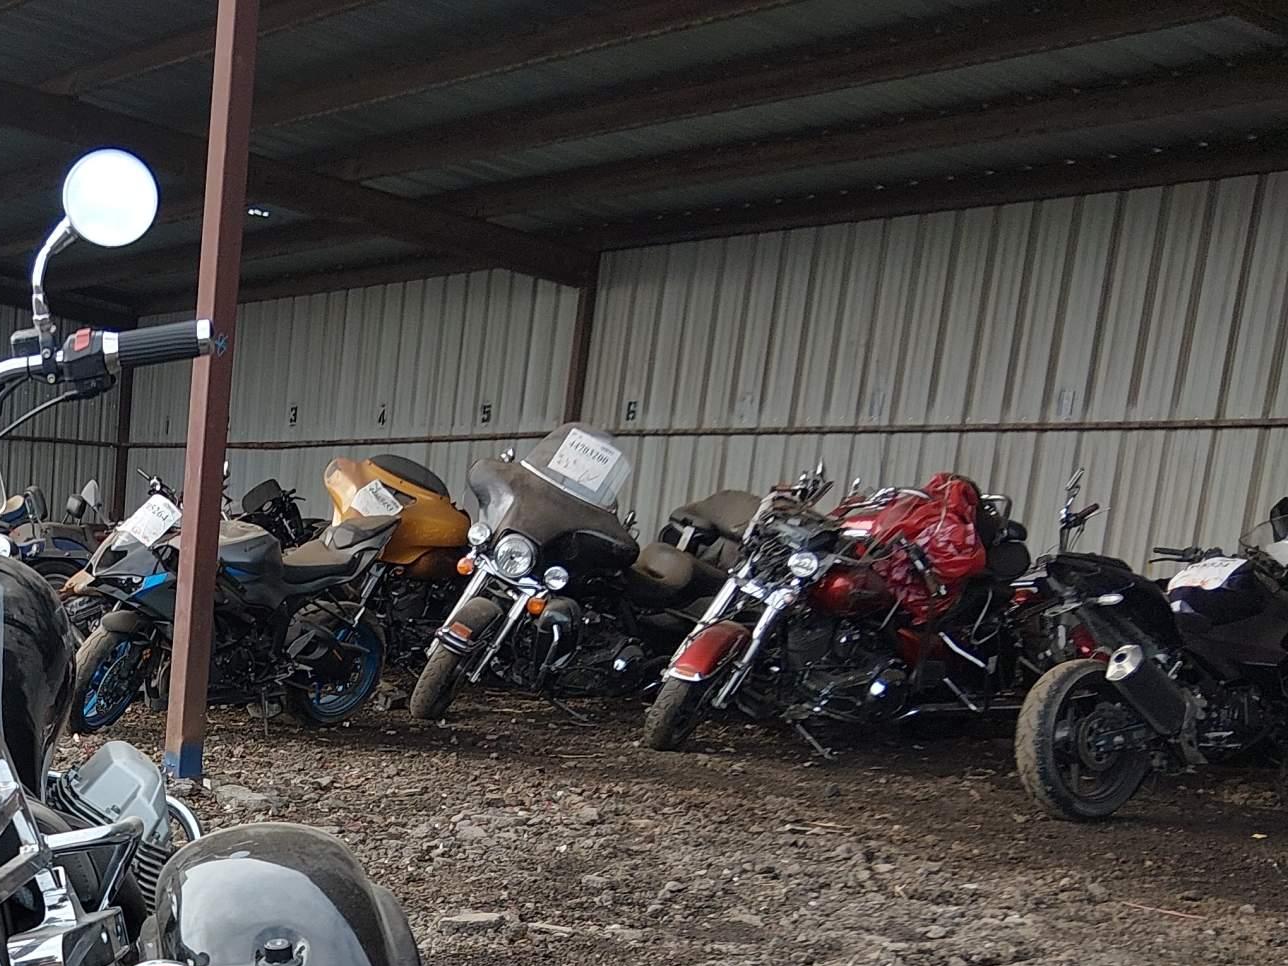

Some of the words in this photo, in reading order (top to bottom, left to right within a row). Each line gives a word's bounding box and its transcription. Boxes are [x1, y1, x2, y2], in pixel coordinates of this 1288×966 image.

[289, 405, 298, 425] 3
[481, 404, 492, 424] 5
[625, 401, 638, 421] 6
